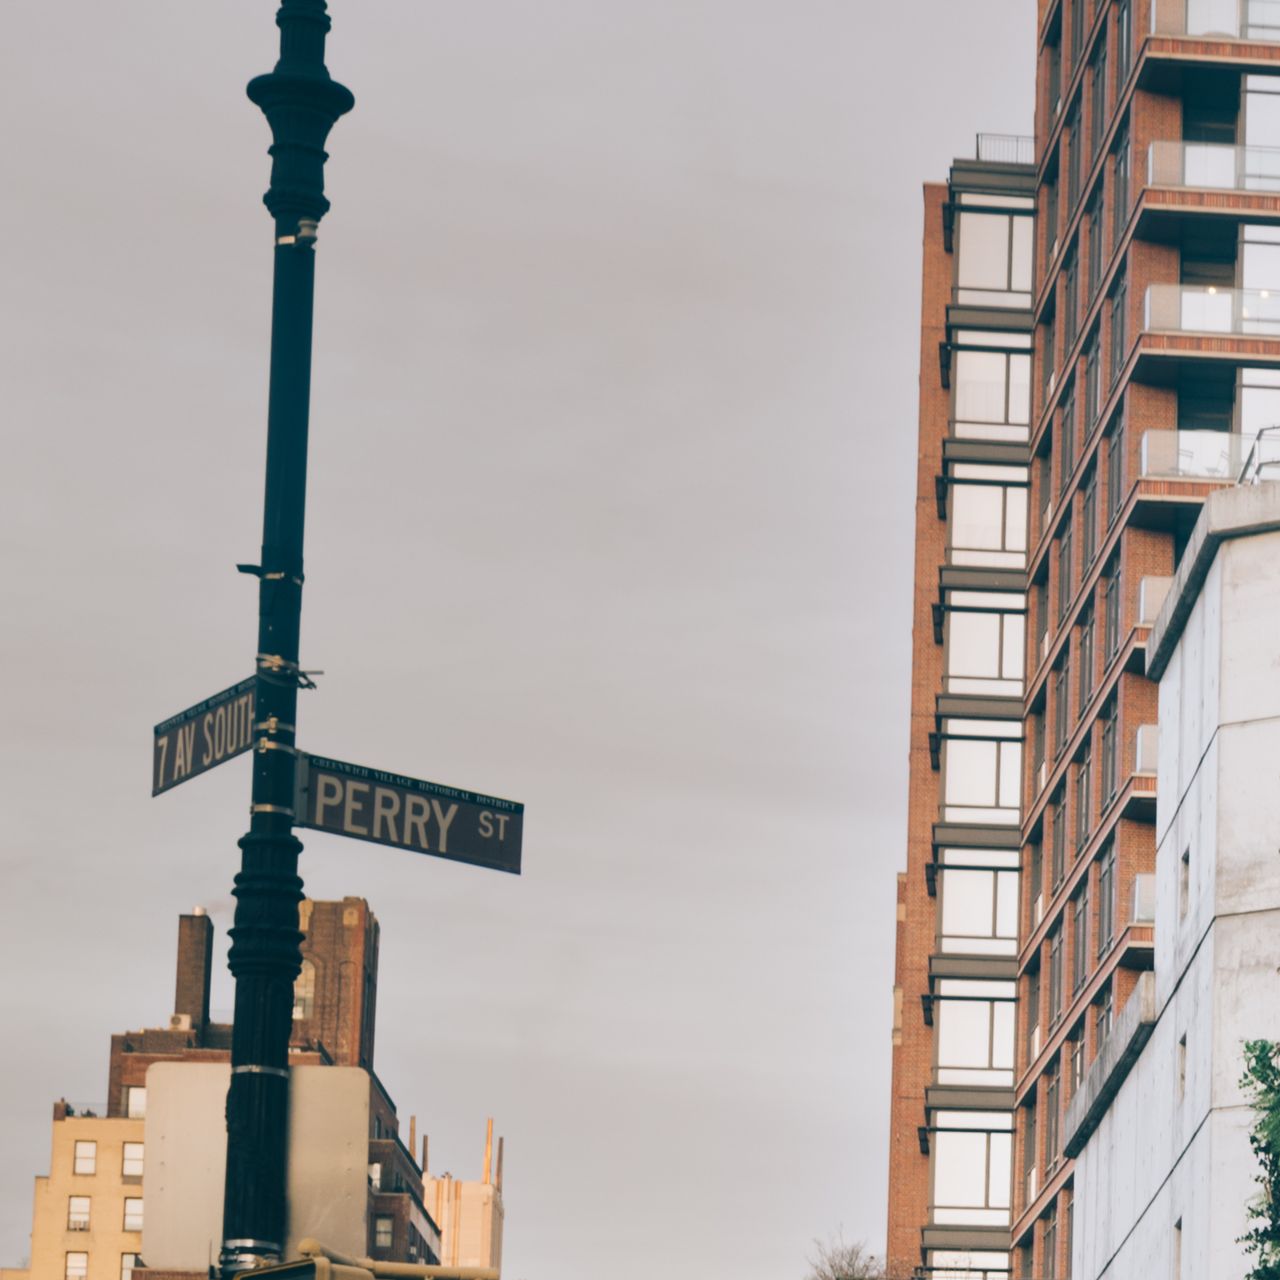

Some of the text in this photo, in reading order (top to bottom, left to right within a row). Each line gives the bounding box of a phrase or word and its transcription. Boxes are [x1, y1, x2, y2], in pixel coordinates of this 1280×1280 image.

[157, 735, 169, 788] 7
[173, 721, 196, 781] AV
[315, 773, 510, 853] PERRY ST
[374, 769, 413, 787] VILLAGE
[418, 781, 471, 800] HISTORICAL
[476, 795, 516, 811] DISTRICT
